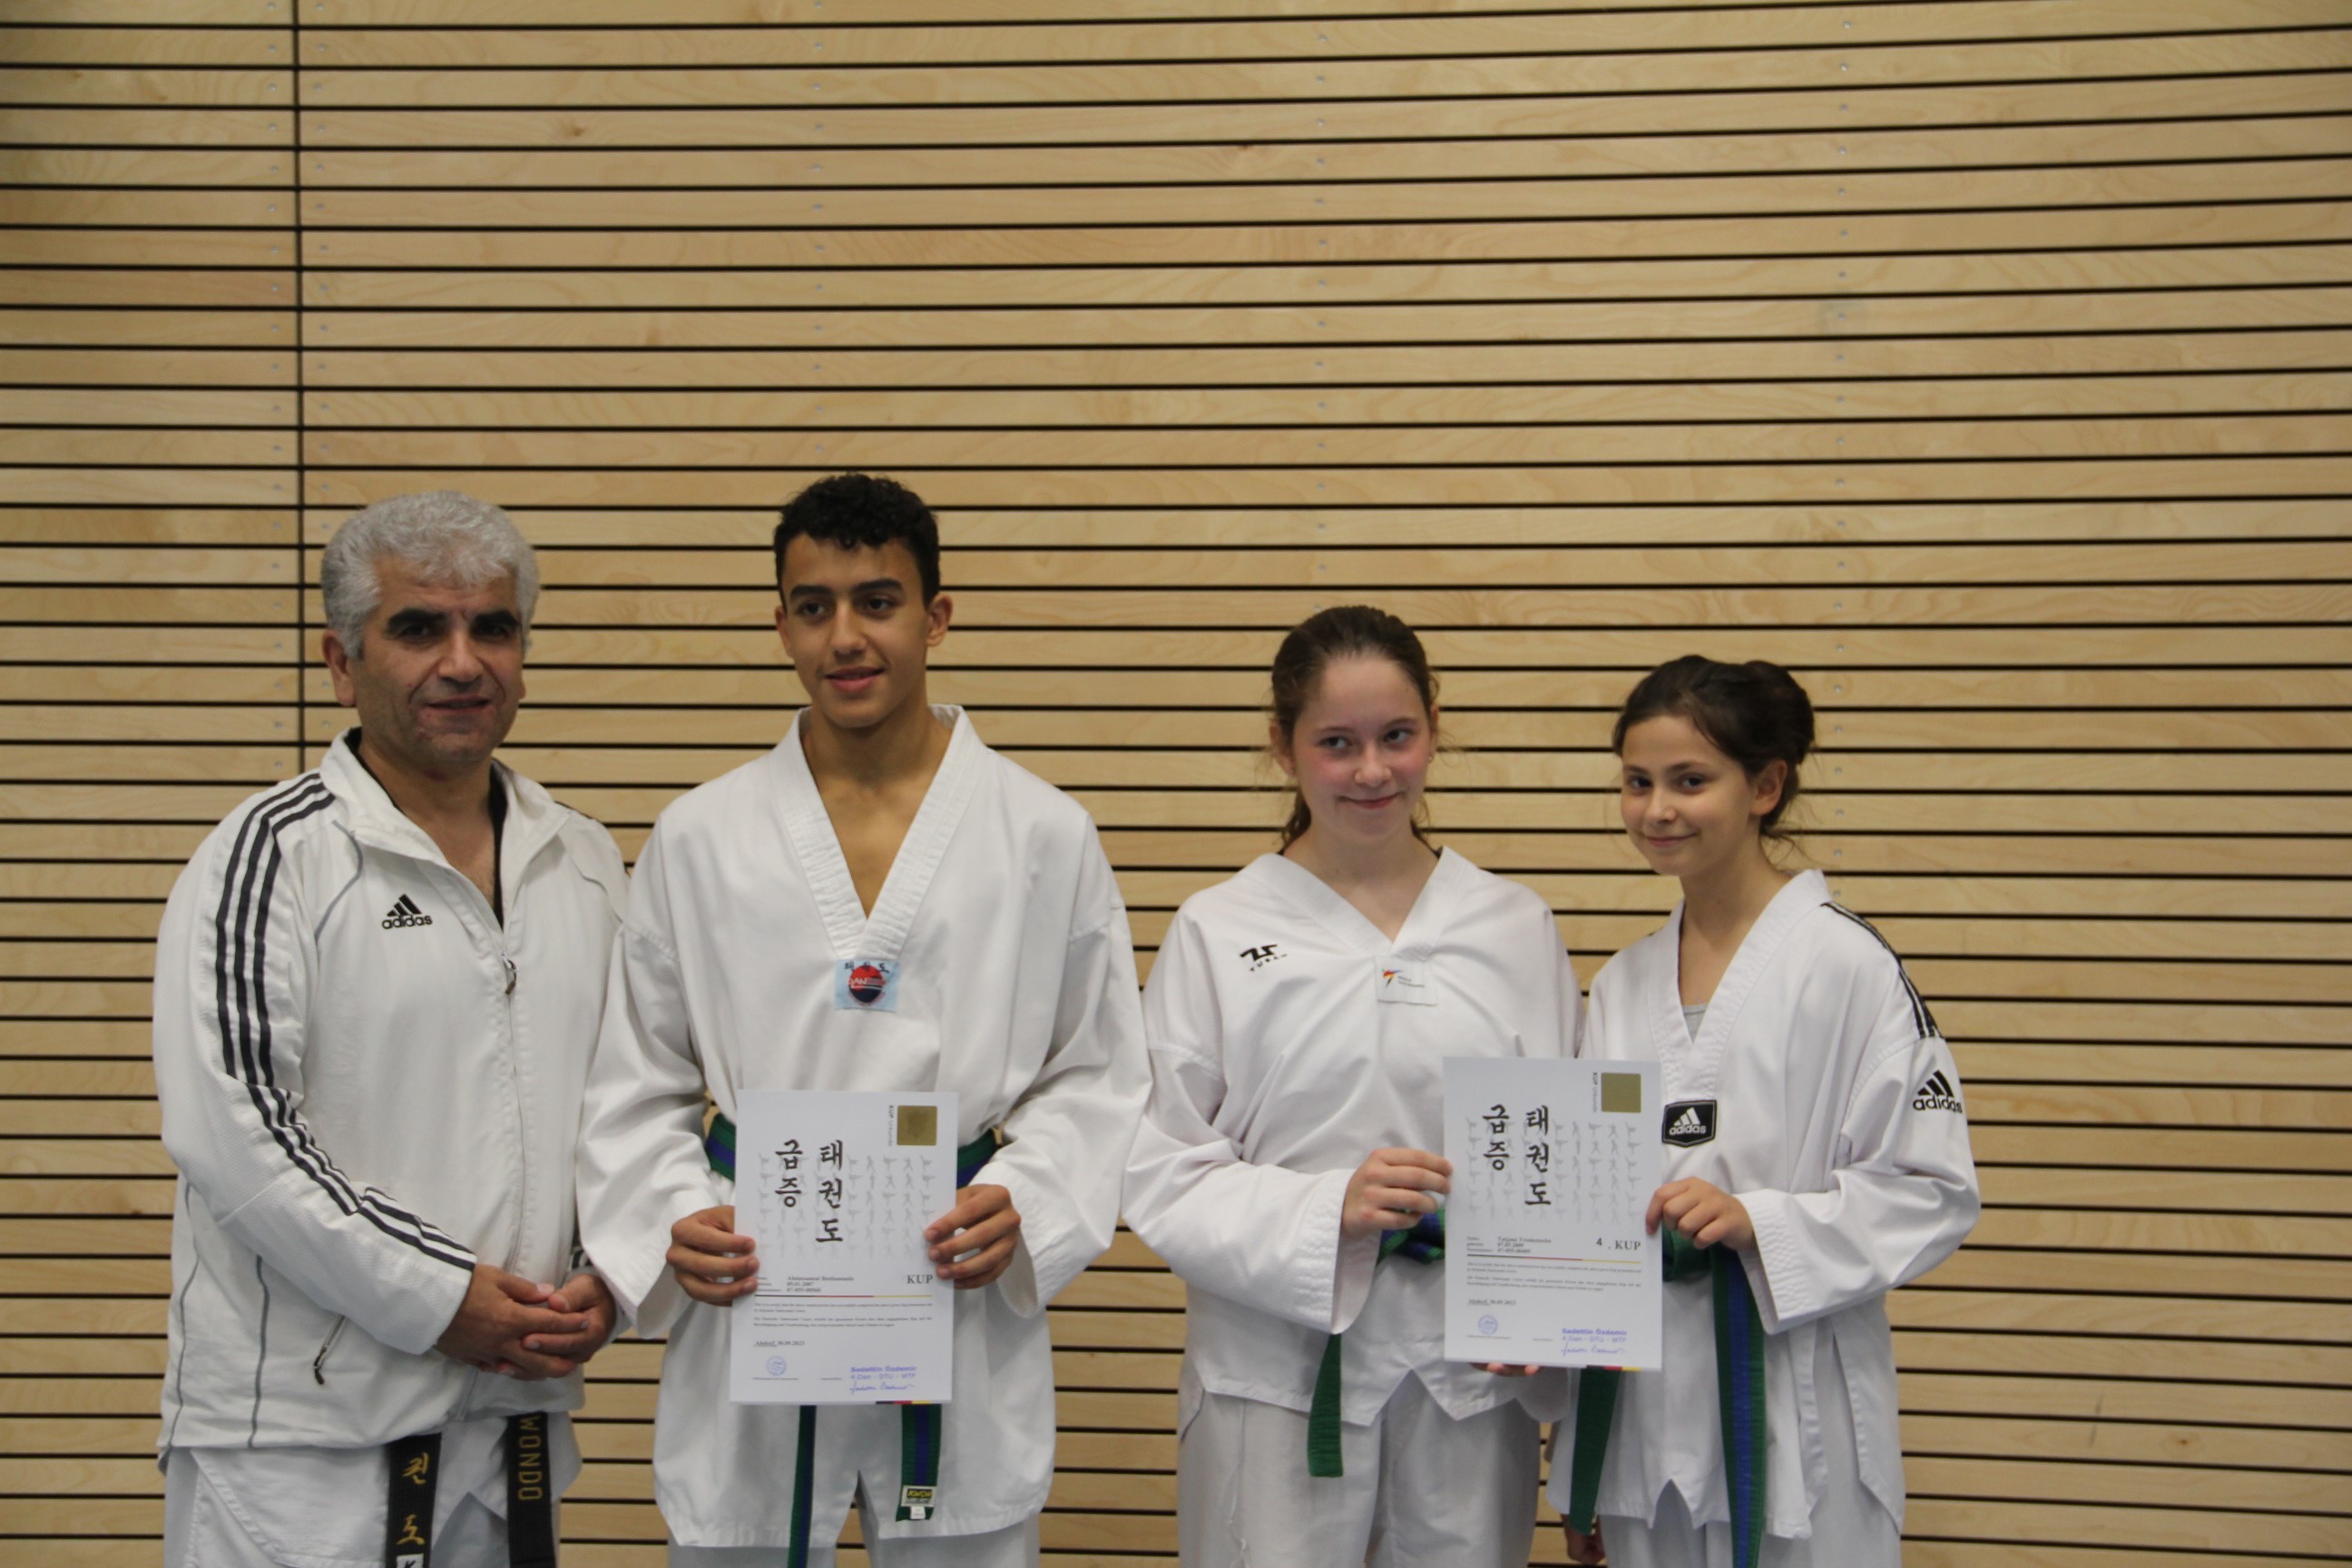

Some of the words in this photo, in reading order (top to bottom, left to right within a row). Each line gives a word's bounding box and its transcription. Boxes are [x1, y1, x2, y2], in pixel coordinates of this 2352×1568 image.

[382, 914, 433, 929] adidas
[1913, 1094, 1963, 1113] adidas
[1483, 1103, 1510, 1171] 급증
[1669, 1124, 1707, 1135] adidas
[1524, 1104, 1552, 1205] 태권도
[774, 1139, 803, 1208] 급증
[816, 1139, 844, 1243] 태권도
[1614, 1240, 1642, 1250] KUP
[906, 1274, 934, 1285] KUP
